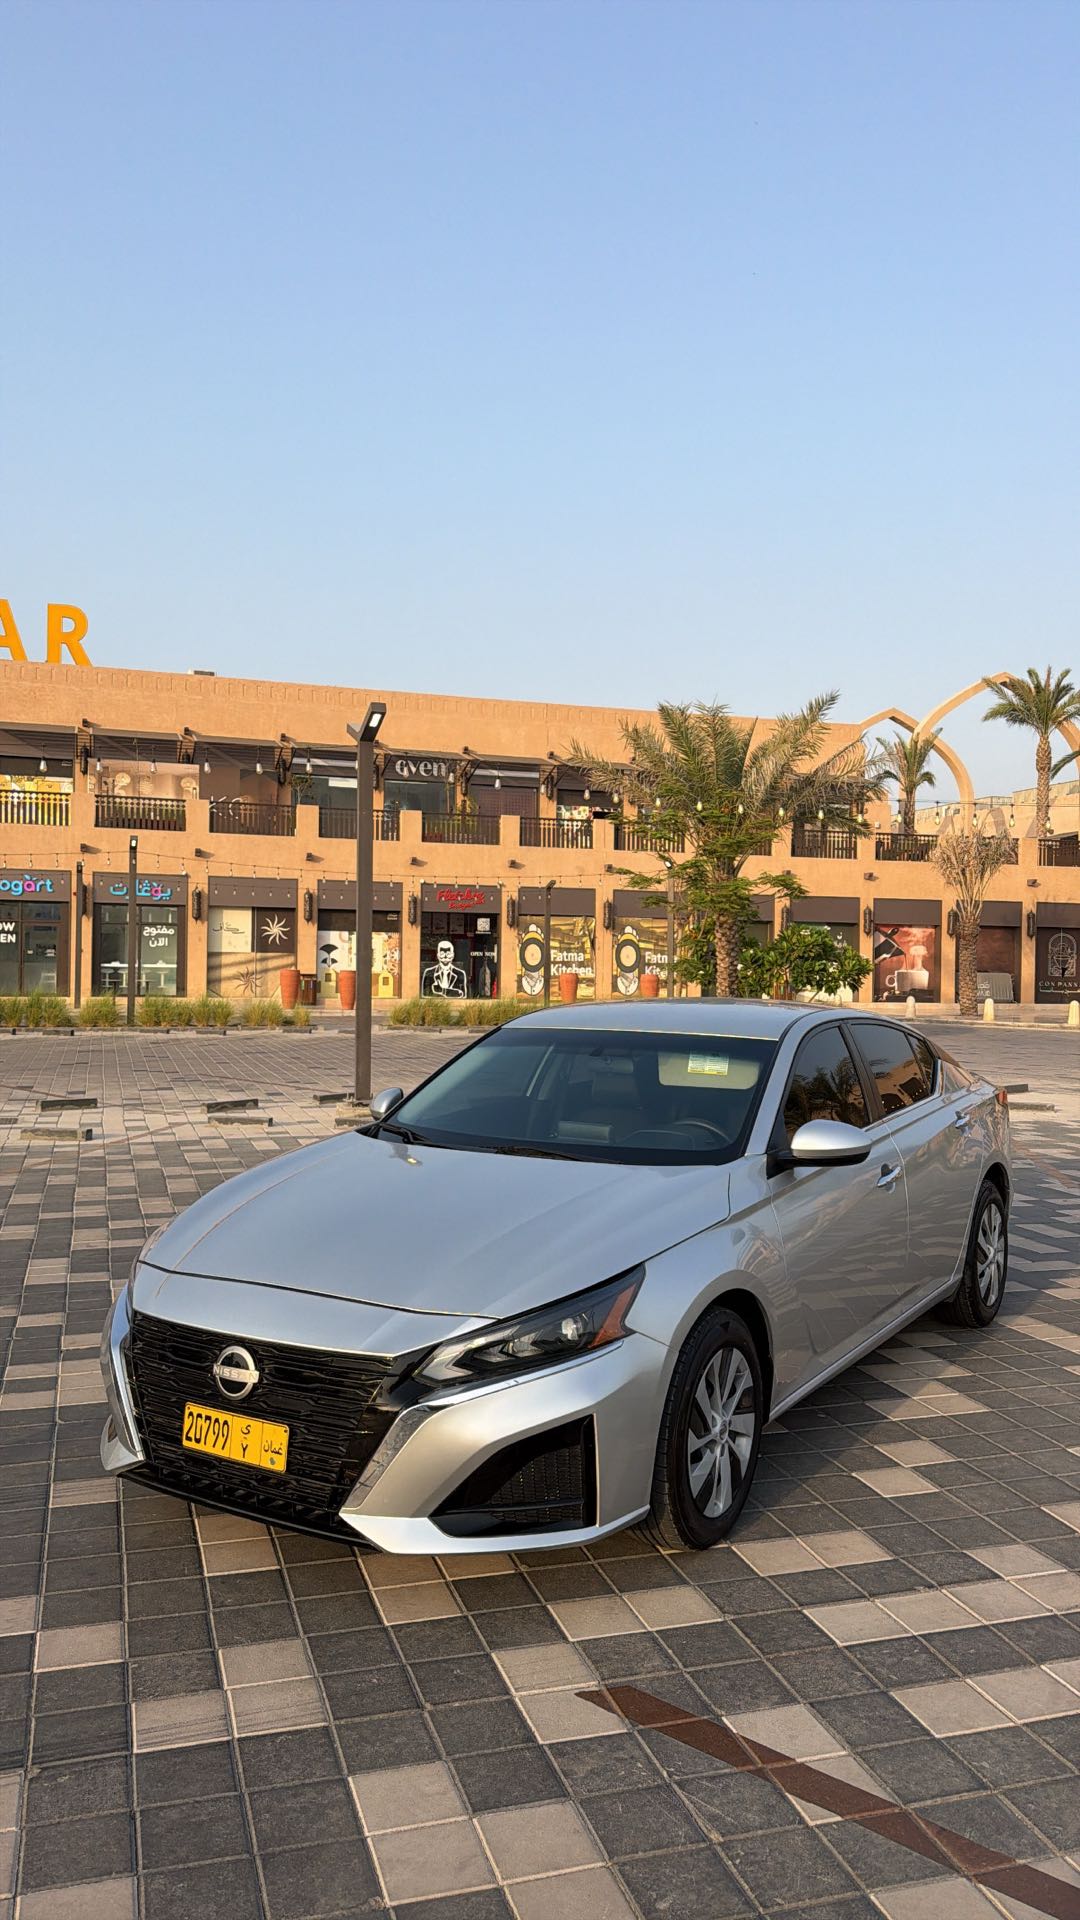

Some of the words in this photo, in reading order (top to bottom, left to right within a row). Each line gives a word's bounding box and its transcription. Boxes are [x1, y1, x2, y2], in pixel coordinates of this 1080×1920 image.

[143, 925, 175, 937] مفتوح
[550, 949, 584, 961] Fatma
[550, 963, 592, 977] Kitchen
[185, 1411, 230, 1450] 20799
[240, 1442, 249, 1458] Y
